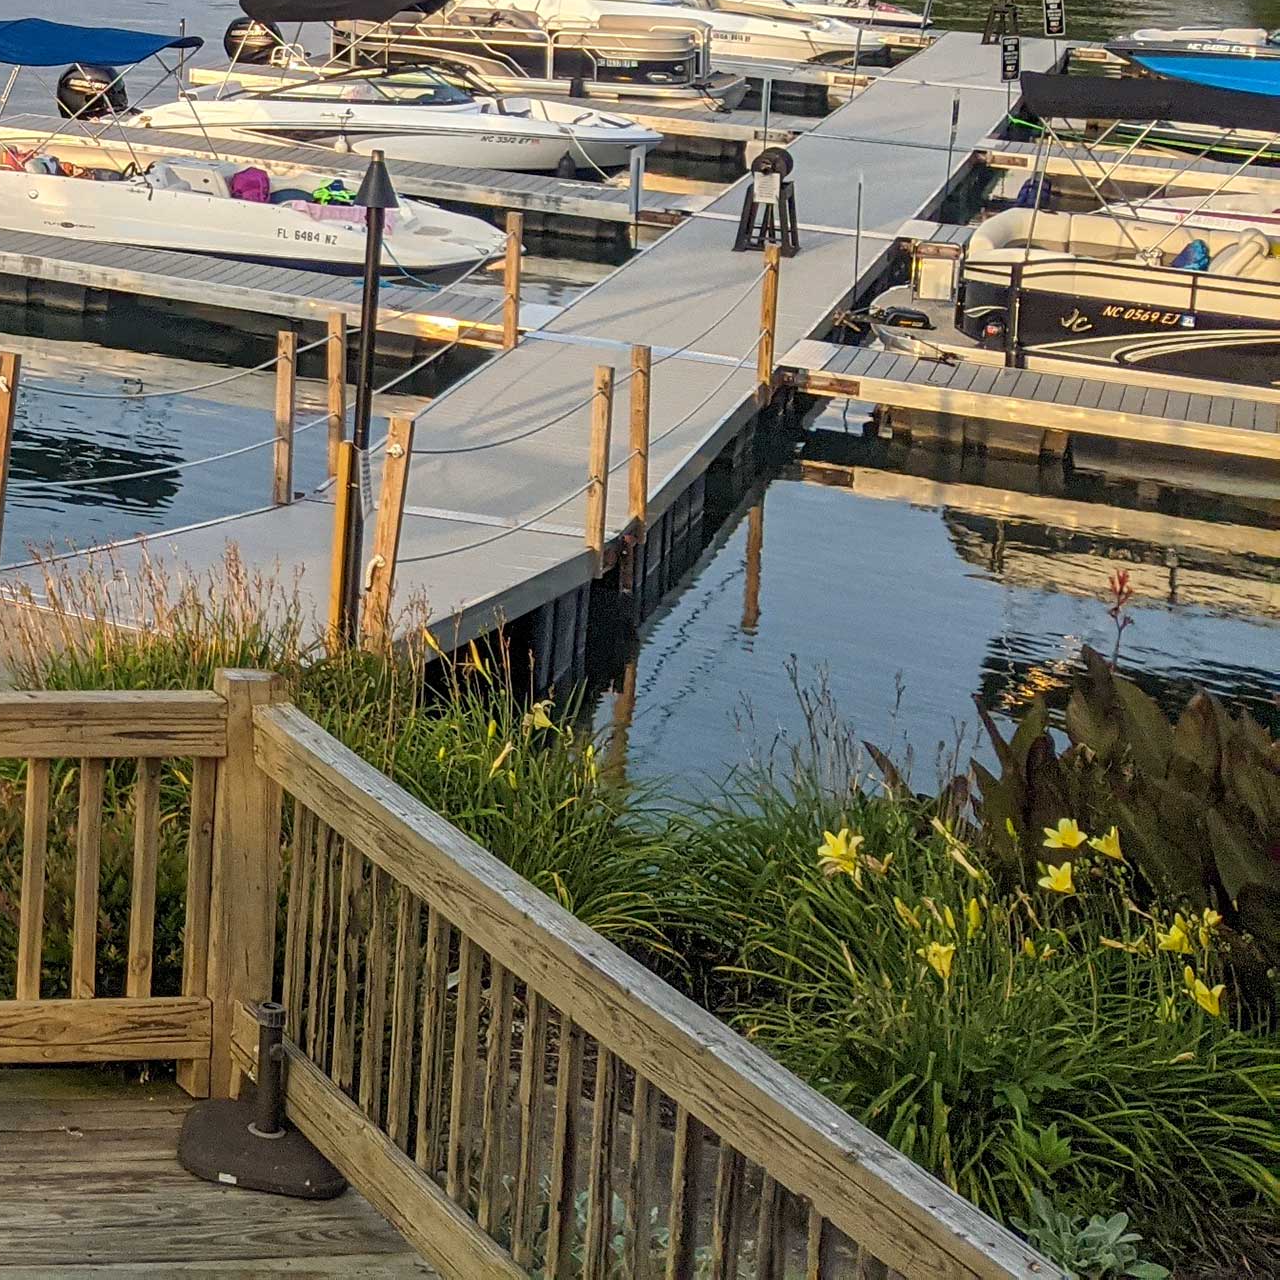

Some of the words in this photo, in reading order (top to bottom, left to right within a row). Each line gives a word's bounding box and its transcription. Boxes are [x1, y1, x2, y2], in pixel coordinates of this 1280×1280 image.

[277, 227, 289, 239] FL
[294, 230, 320, 242] 6484
[325, 234, 338, 246] NZ
[1102, 305, 1125, 318] NC
[1124, 308, 1160, 322] 0569
[1161, 312, 1182, 325] EJ
